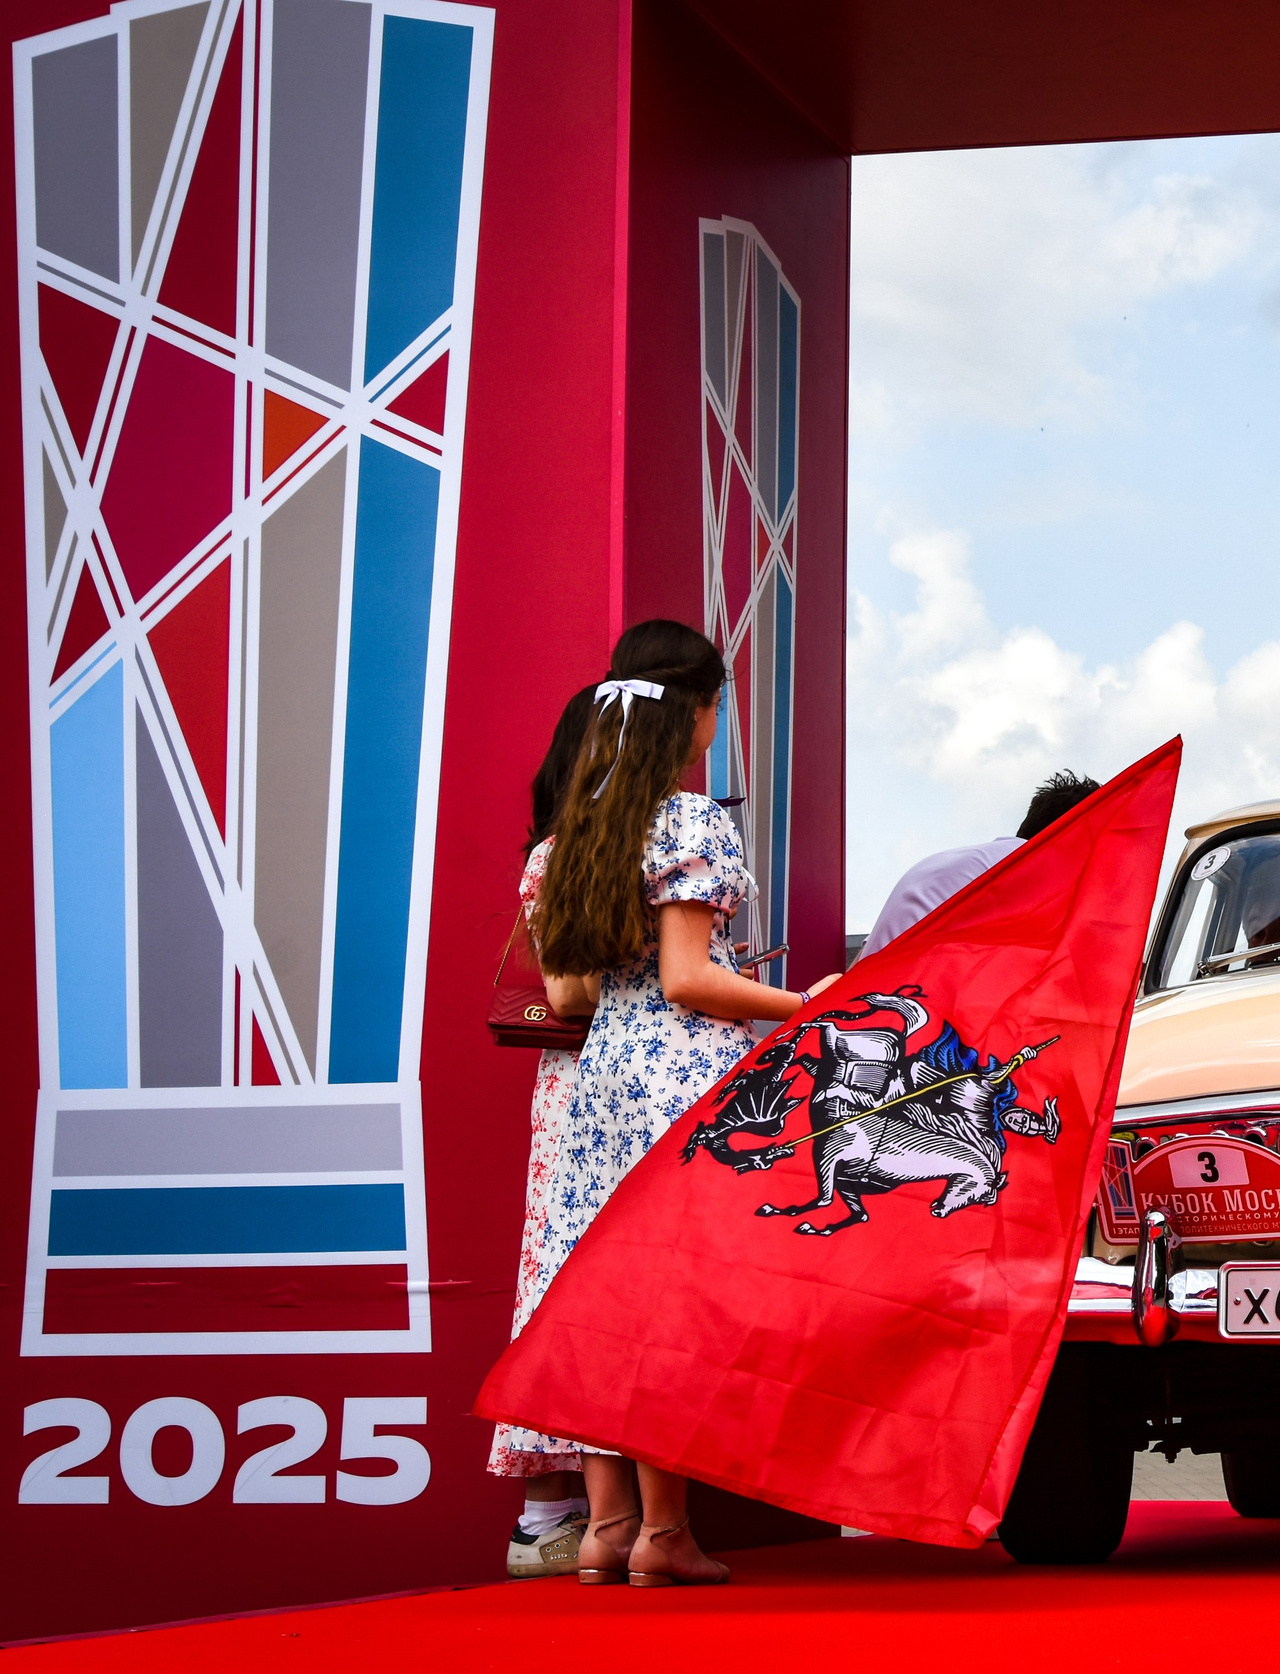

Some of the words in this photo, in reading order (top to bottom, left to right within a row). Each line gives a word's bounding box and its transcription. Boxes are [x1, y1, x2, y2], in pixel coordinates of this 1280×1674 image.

[1204, 854, 1217, 870] 3
[1197, 1151, 1220, 1183] 3
[1140, 1192, 1217, 1215] КУБОК
[1176, 1211, 1280, 1223] СТОРИЧЕСКОМУ
[18, 1395, 431, 1507] 2025
